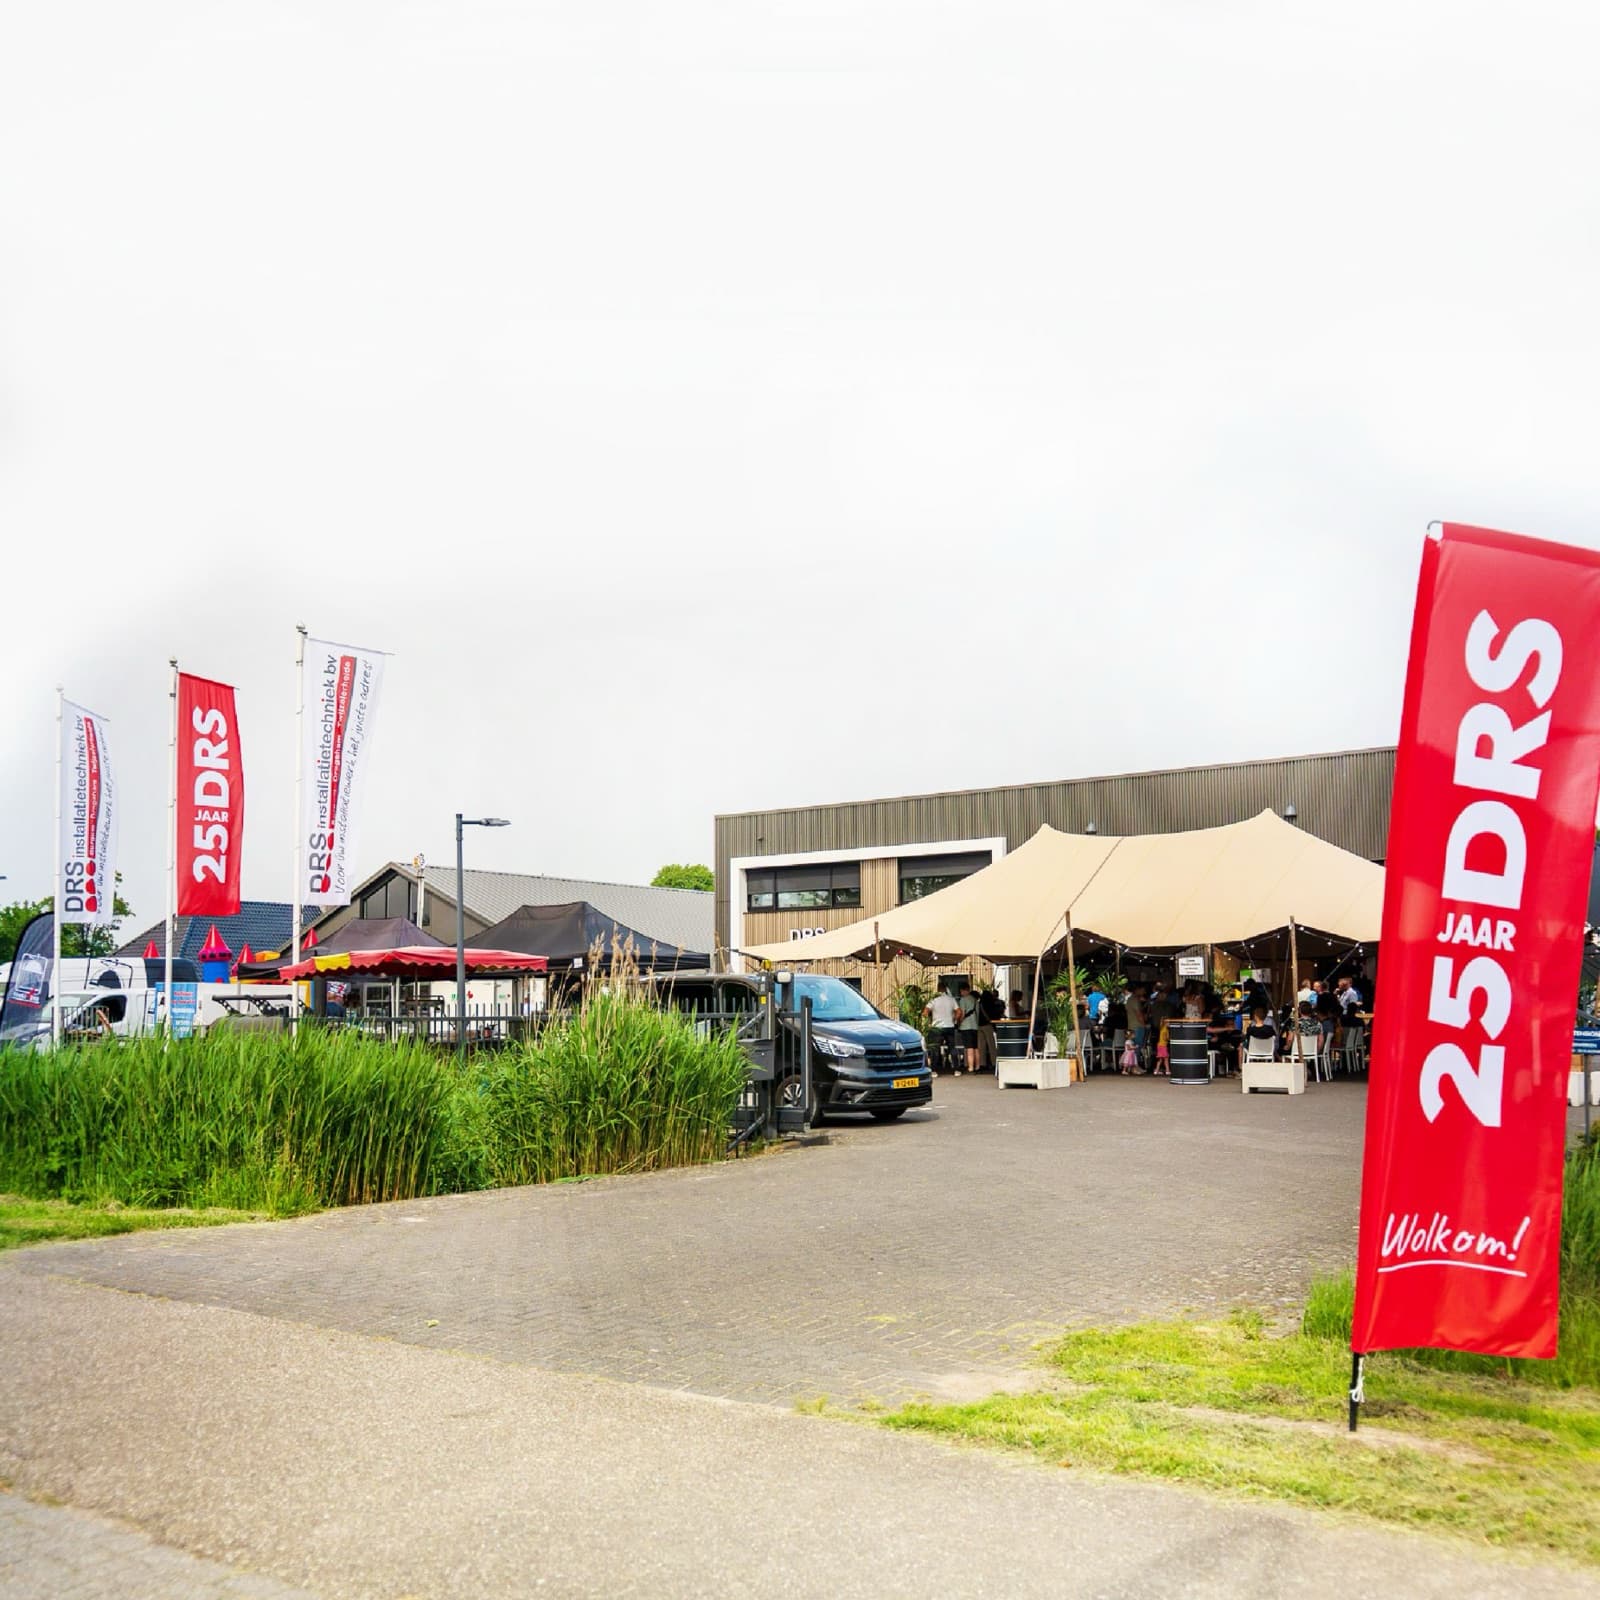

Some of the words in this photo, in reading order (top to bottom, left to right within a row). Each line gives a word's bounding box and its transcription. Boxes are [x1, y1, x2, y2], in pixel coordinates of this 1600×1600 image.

[323, 654, 337, 675] bv
[74, 715, 85, 731] bv
[192, 705, 230, 809] DRS
[316, 679, 336, 829] installatietechniek
[1441, 609, 1563, 910] DRS
[72, 734, 87, 858] installatietechniek
[194, 809, 229, 823] JAAR
[334, 864, 346, 894] Voor
[352, 702, 366, 736] juiste
[192, 823, 229, 884] 25
[309, 832, 327, 893] DRS
[65, 861, 84, 912] DRS
[1437, 911, 1516, 951] JAAR
[1419, 955, 1512, 1128] 25
[1381, 1212, 1531, 1261] Wolkom!
